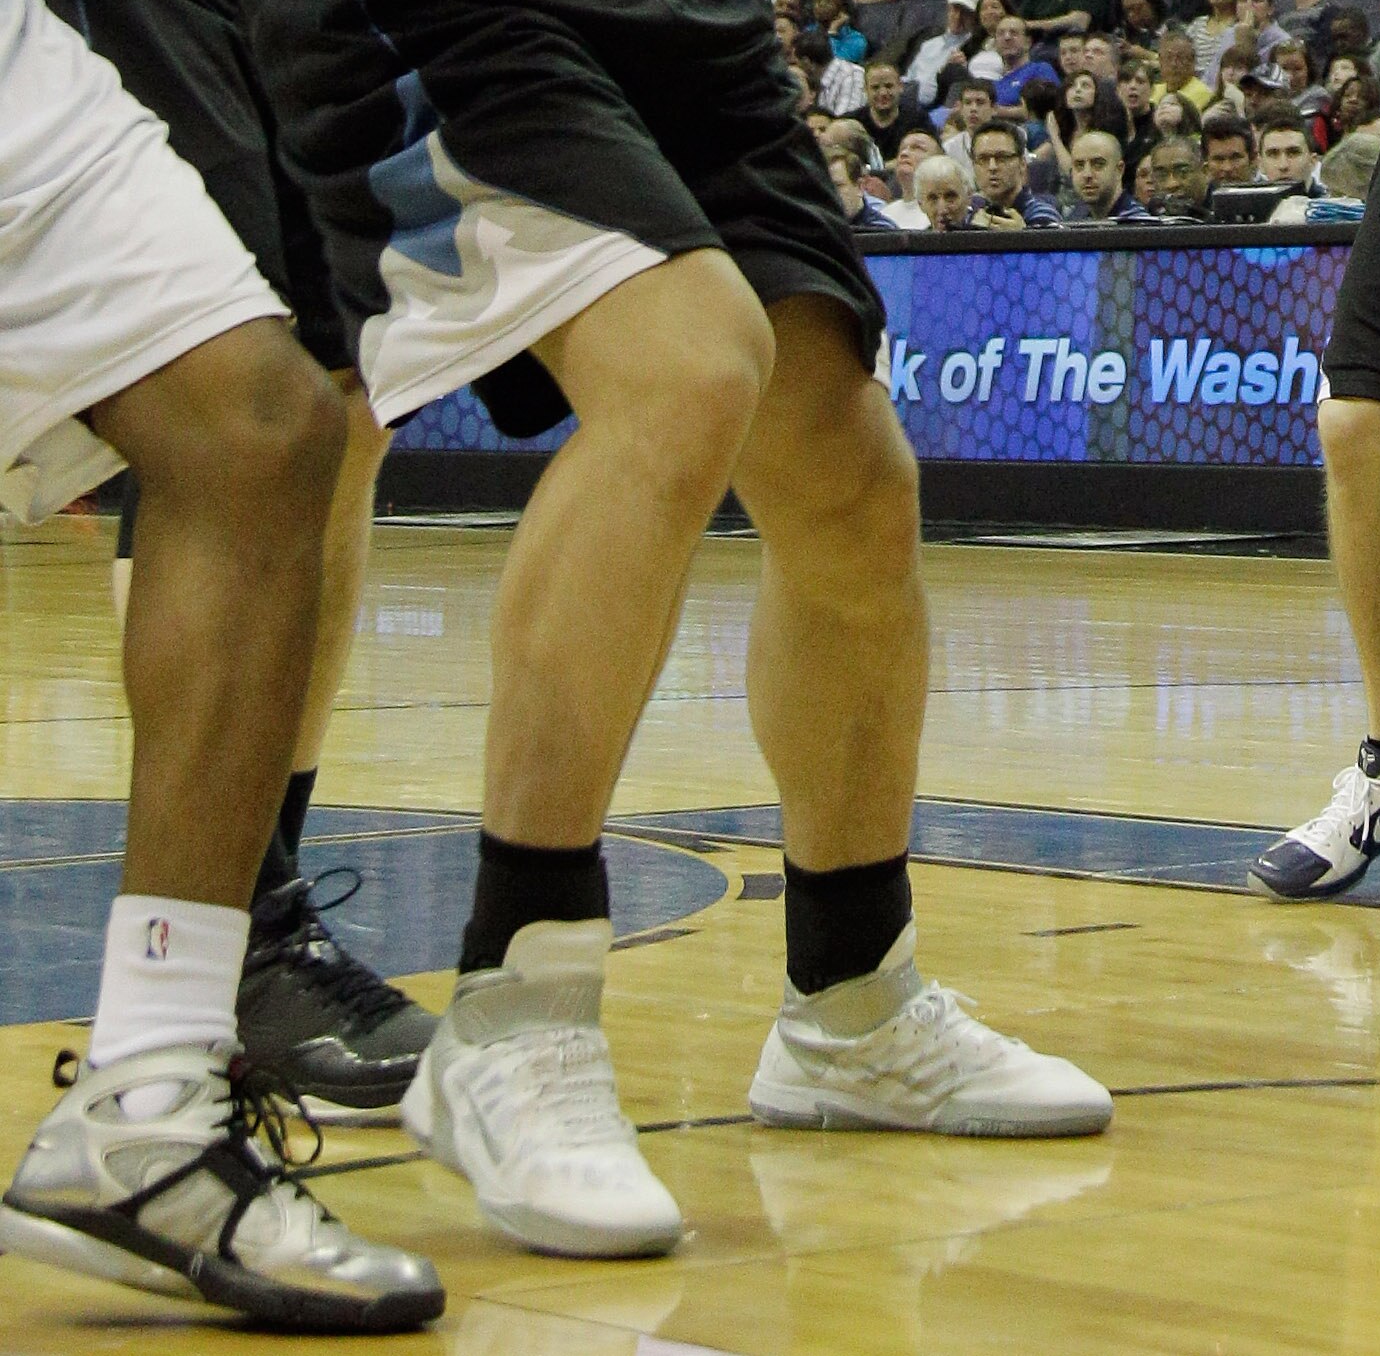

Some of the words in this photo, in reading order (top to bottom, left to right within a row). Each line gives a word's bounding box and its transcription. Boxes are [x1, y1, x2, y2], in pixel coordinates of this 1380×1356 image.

[939, 337, 1005, 404] of
[1018, 337, 1128, 404] The
[1149, 336, 1320, 405] Wash
